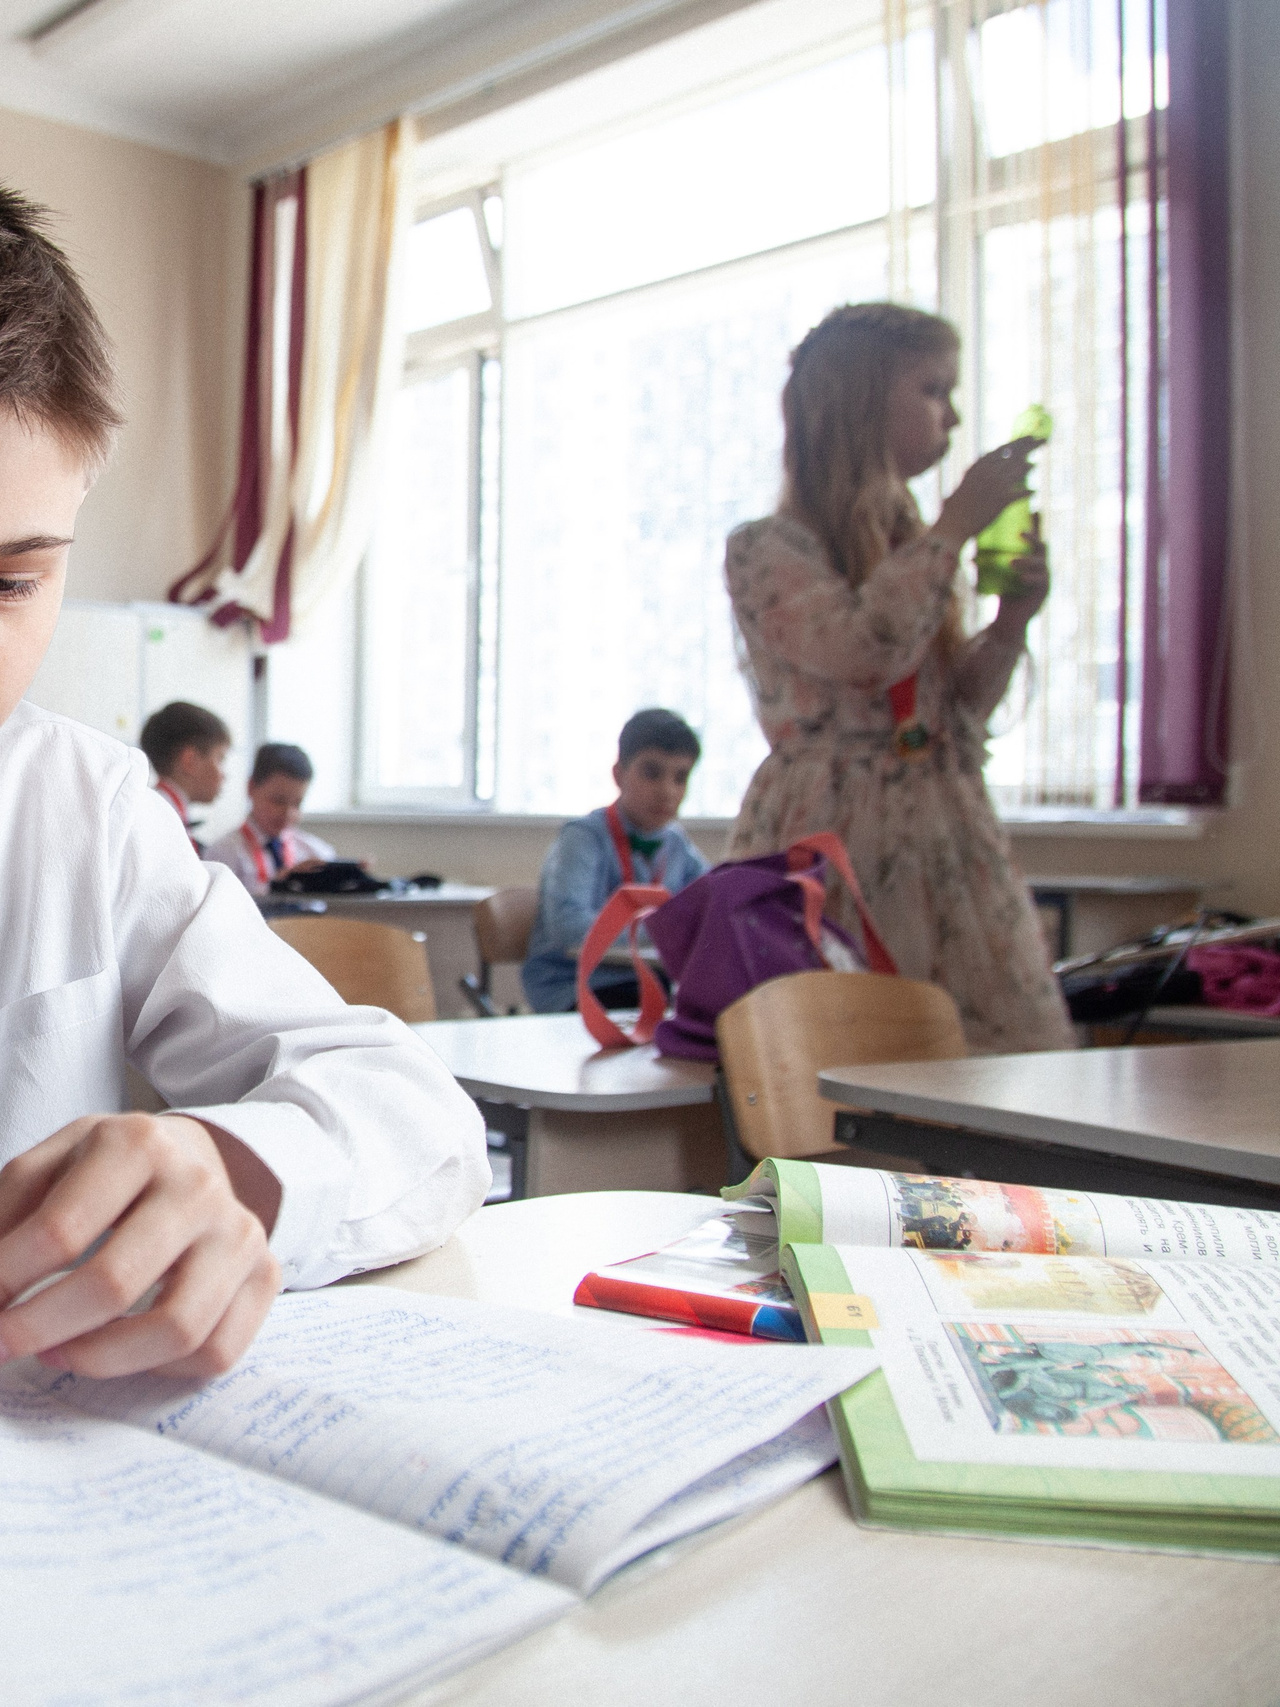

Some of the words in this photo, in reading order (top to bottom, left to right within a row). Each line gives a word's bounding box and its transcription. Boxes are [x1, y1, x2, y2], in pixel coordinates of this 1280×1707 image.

[1160, 1238, 1172, 1254] на
[1172, 1219, 1191, 1255] Крем-
[1196, 1206, 1226, 1258] выступили
[1243, 1225, 1263, 1261] могли
[846, 1305, 863, 1317] 61
